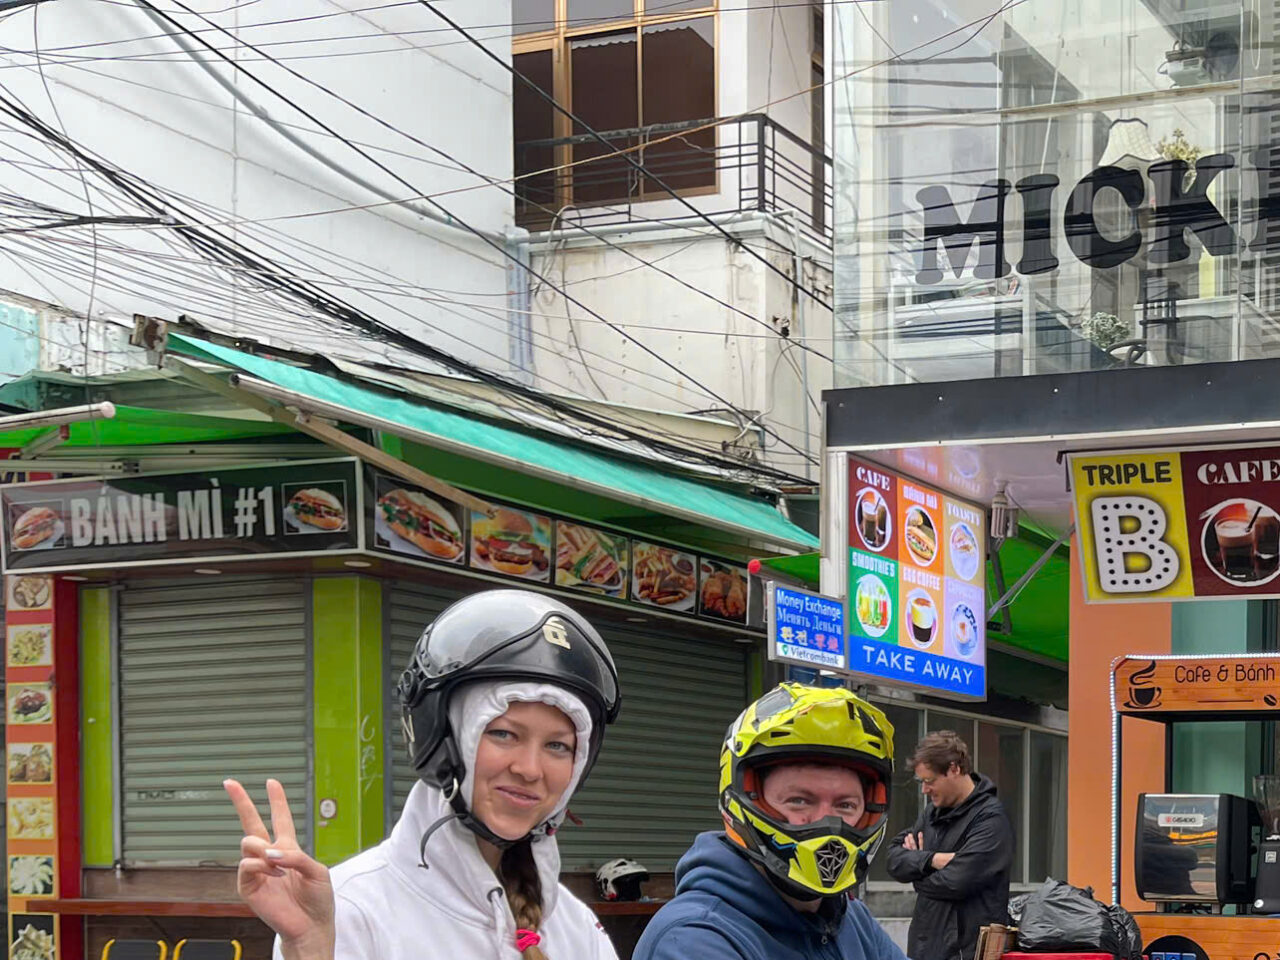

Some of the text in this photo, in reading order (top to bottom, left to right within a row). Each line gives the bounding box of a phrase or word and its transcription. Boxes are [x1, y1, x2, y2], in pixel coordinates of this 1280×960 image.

[856, 466, 890, 492] CAFE
[1081, 460, 1173, 487] TRIPLE
[69, 477, 276, 547] BÁNH MÌ #1
[1091, 495, 1180, 594] B
[776, 589, 841, 621] Money Exchange
[791, 647, 839, 665] Vietcombank
[863, 645, 973, 685] TAKE AWAY
[1174, 665, 1211, 683] Cafe
[1234, 663, 1276, 682] Bánh
